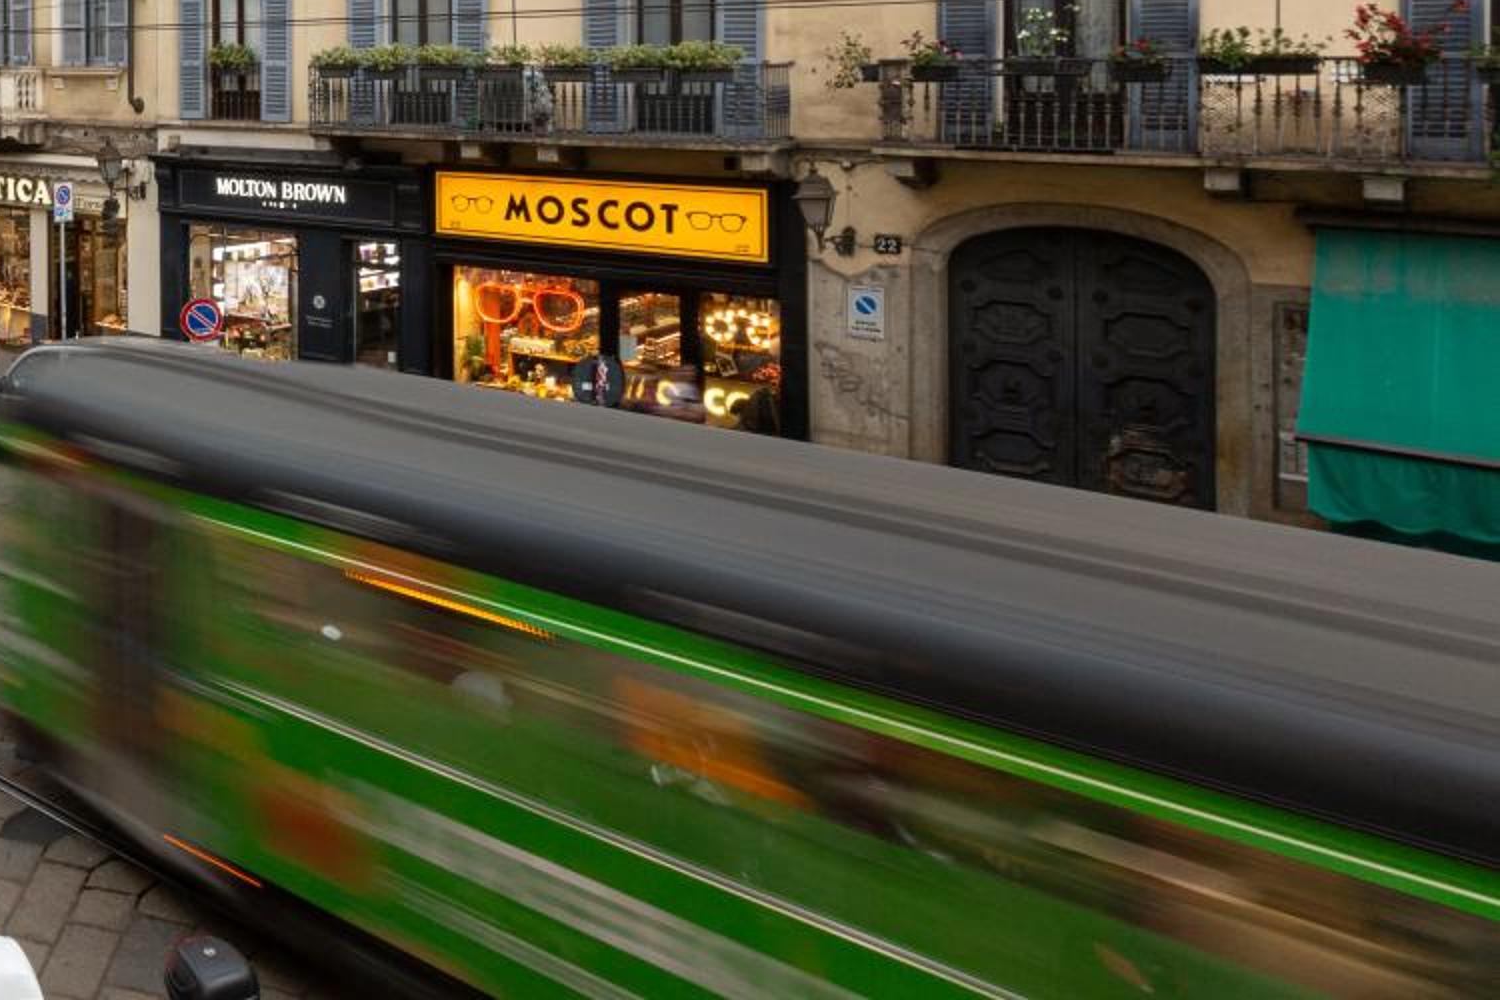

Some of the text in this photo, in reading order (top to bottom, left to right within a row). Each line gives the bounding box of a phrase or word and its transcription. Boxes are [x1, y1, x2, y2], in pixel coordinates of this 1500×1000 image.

[215, 176, 347, 204] MOLTON BROWN
[503, 192, 680, 235] MOSCOT
[876, 237, 899, 253] 22
